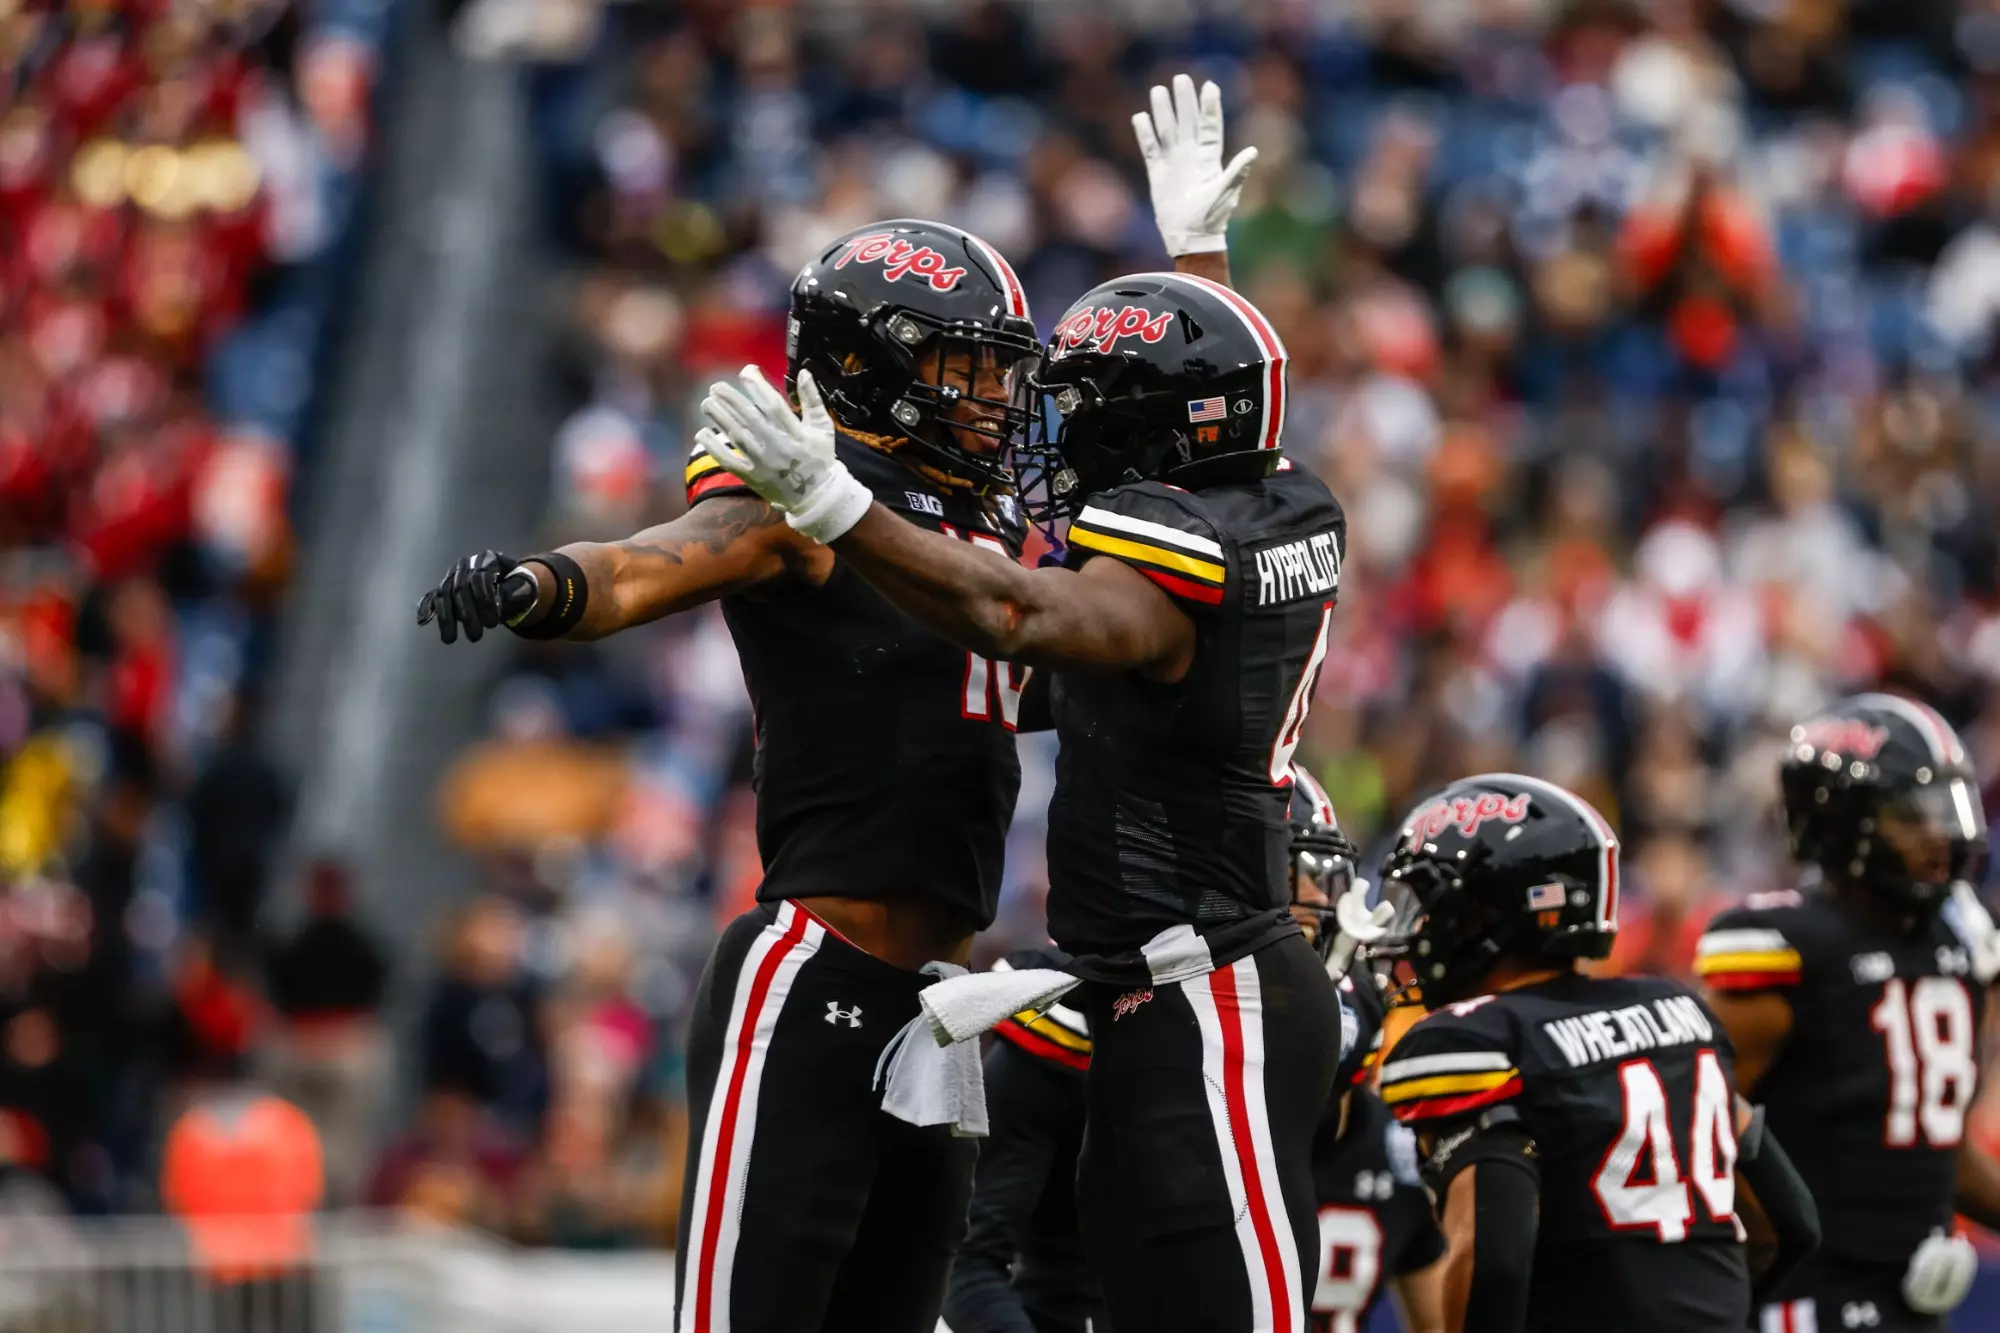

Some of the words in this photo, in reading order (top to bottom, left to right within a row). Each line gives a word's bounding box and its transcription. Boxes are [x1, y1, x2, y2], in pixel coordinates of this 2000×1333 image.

[834, 233, 968, 292] Terps
[1053, 306, 1175, 361] Terps
[1406, 792, 1532, 855] Terps
[1543, 995, 1713, 1068] WHEATLAND
[1868, 975, 1978, 1149] 18
[1588, 1048, 1748, 1244] 44
